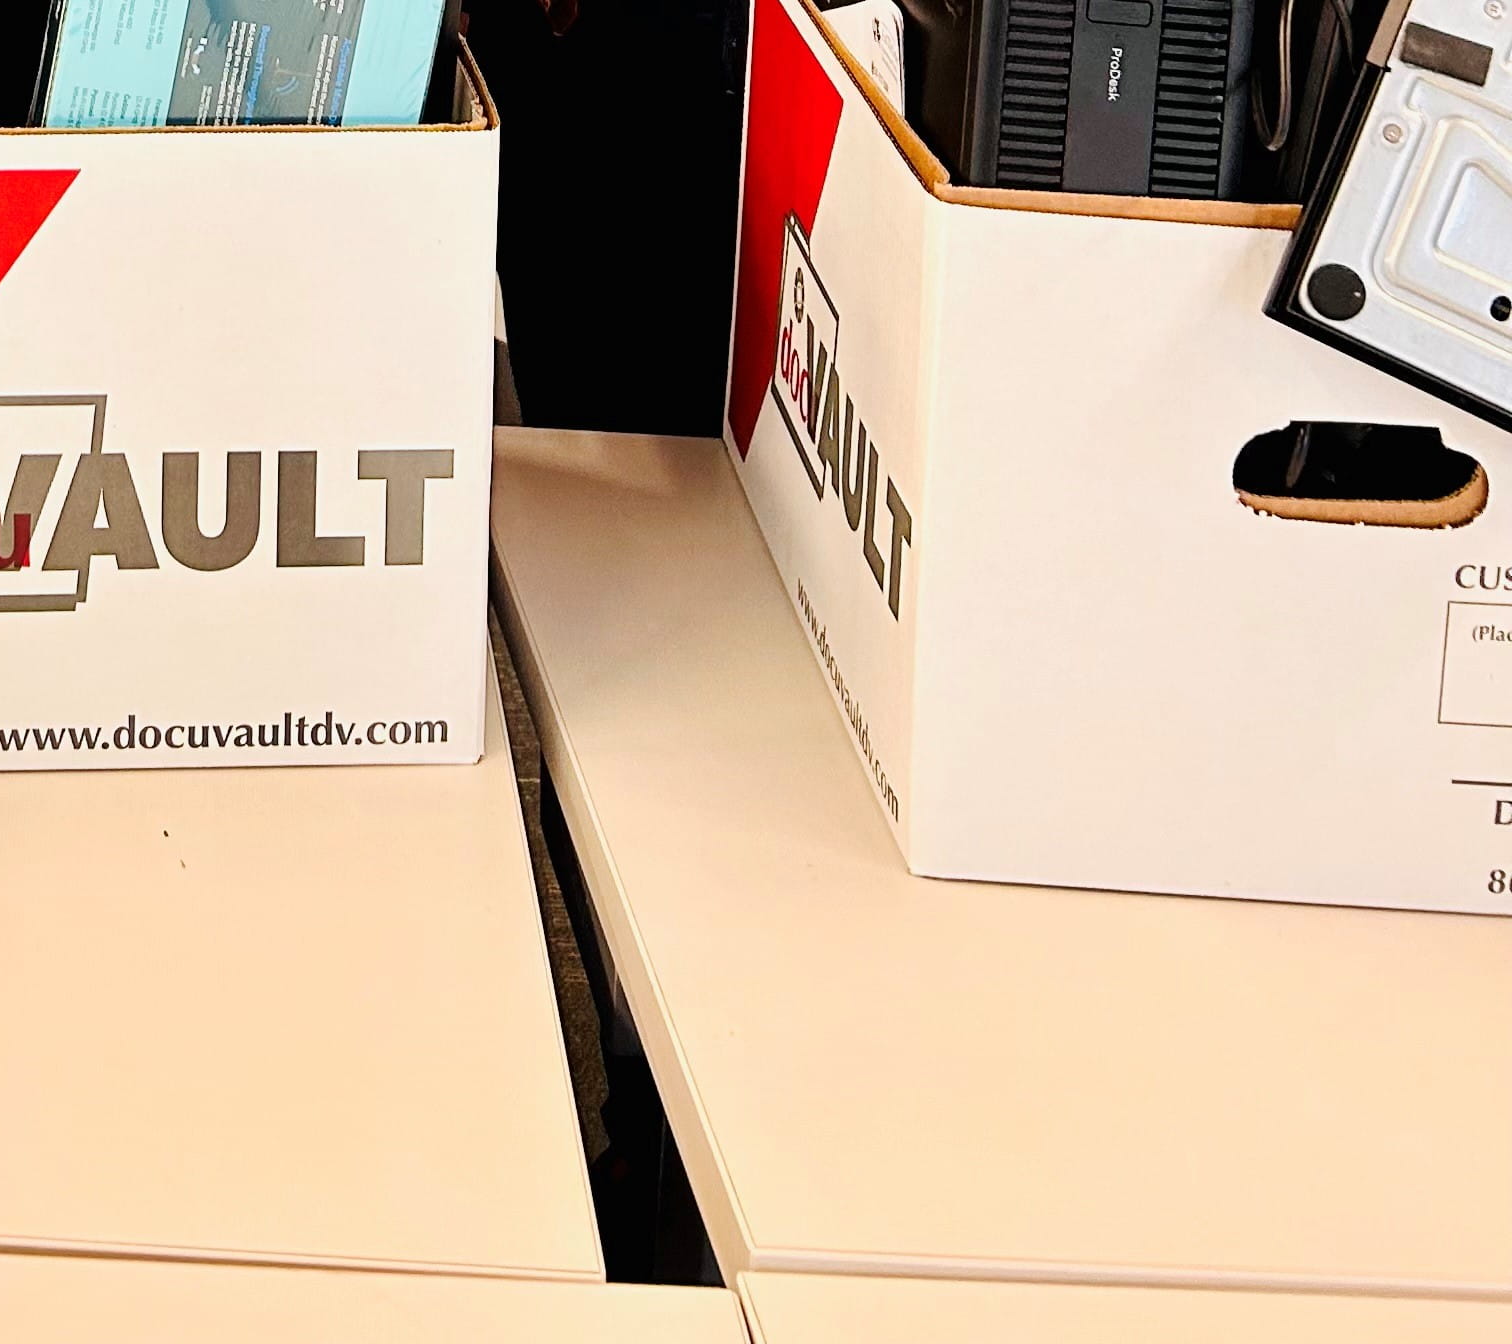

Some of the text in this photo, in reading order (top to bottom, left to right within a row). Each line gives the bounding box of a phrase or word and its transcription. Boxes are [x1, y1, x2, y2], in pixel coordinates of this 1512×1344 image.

[1108, 47, 1123, 102] ProDesk
[807, 314, 913, 622] VAULT
[797, 576, 900, 823] www.docuvaultdv.com
[1487, 869, 1512, 894] 8
